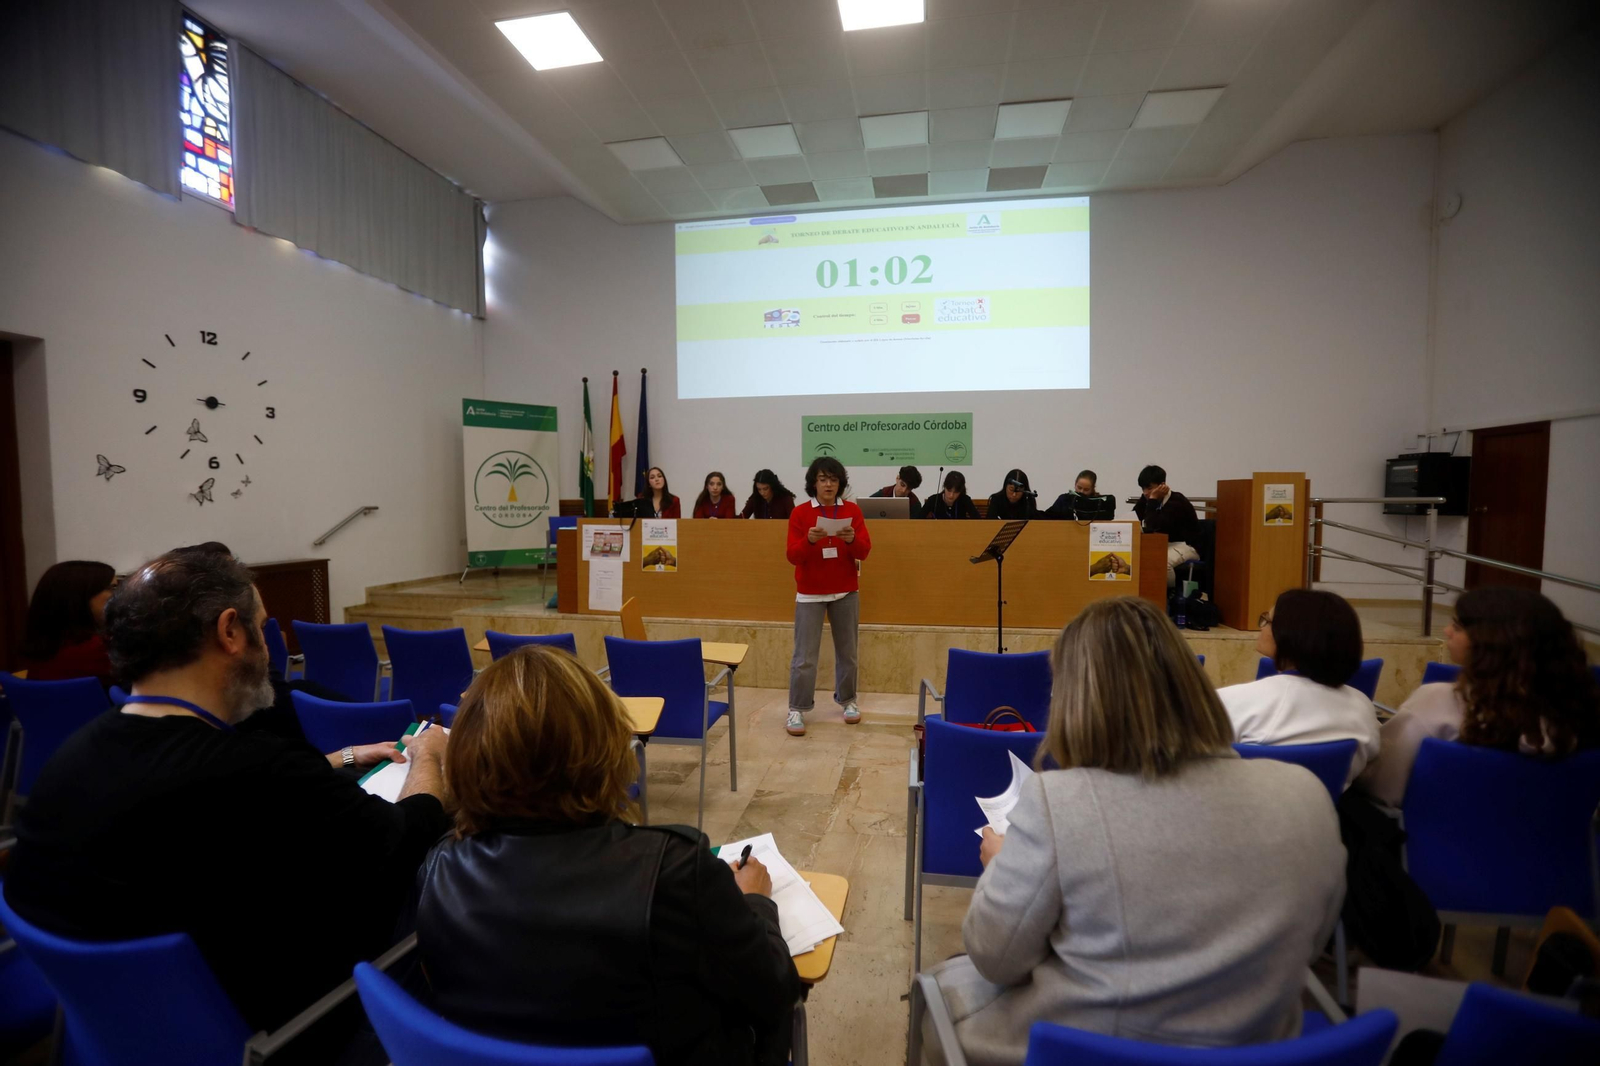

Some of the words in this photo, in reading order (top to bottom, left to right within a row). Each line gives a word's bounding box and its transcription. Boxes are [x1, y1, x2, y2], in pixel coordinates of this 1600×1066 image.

[862, 225, 904, 234] EDUCATIVO
[816, 254, 934, 289] 01:02
[937, 313, 987, 323] educativo
[200, 330, 218, 346] 12
[133, 388, 147, 403] 9
[265, 406, 276, 419] 3
[807, 422, 841, 432] Centro
[842, 421, 858, 432] del
[860, 420, 921, 432] Profesorado
[923, 419, 967, 431] Córdoba
[208, 456, 220, 470] 6
